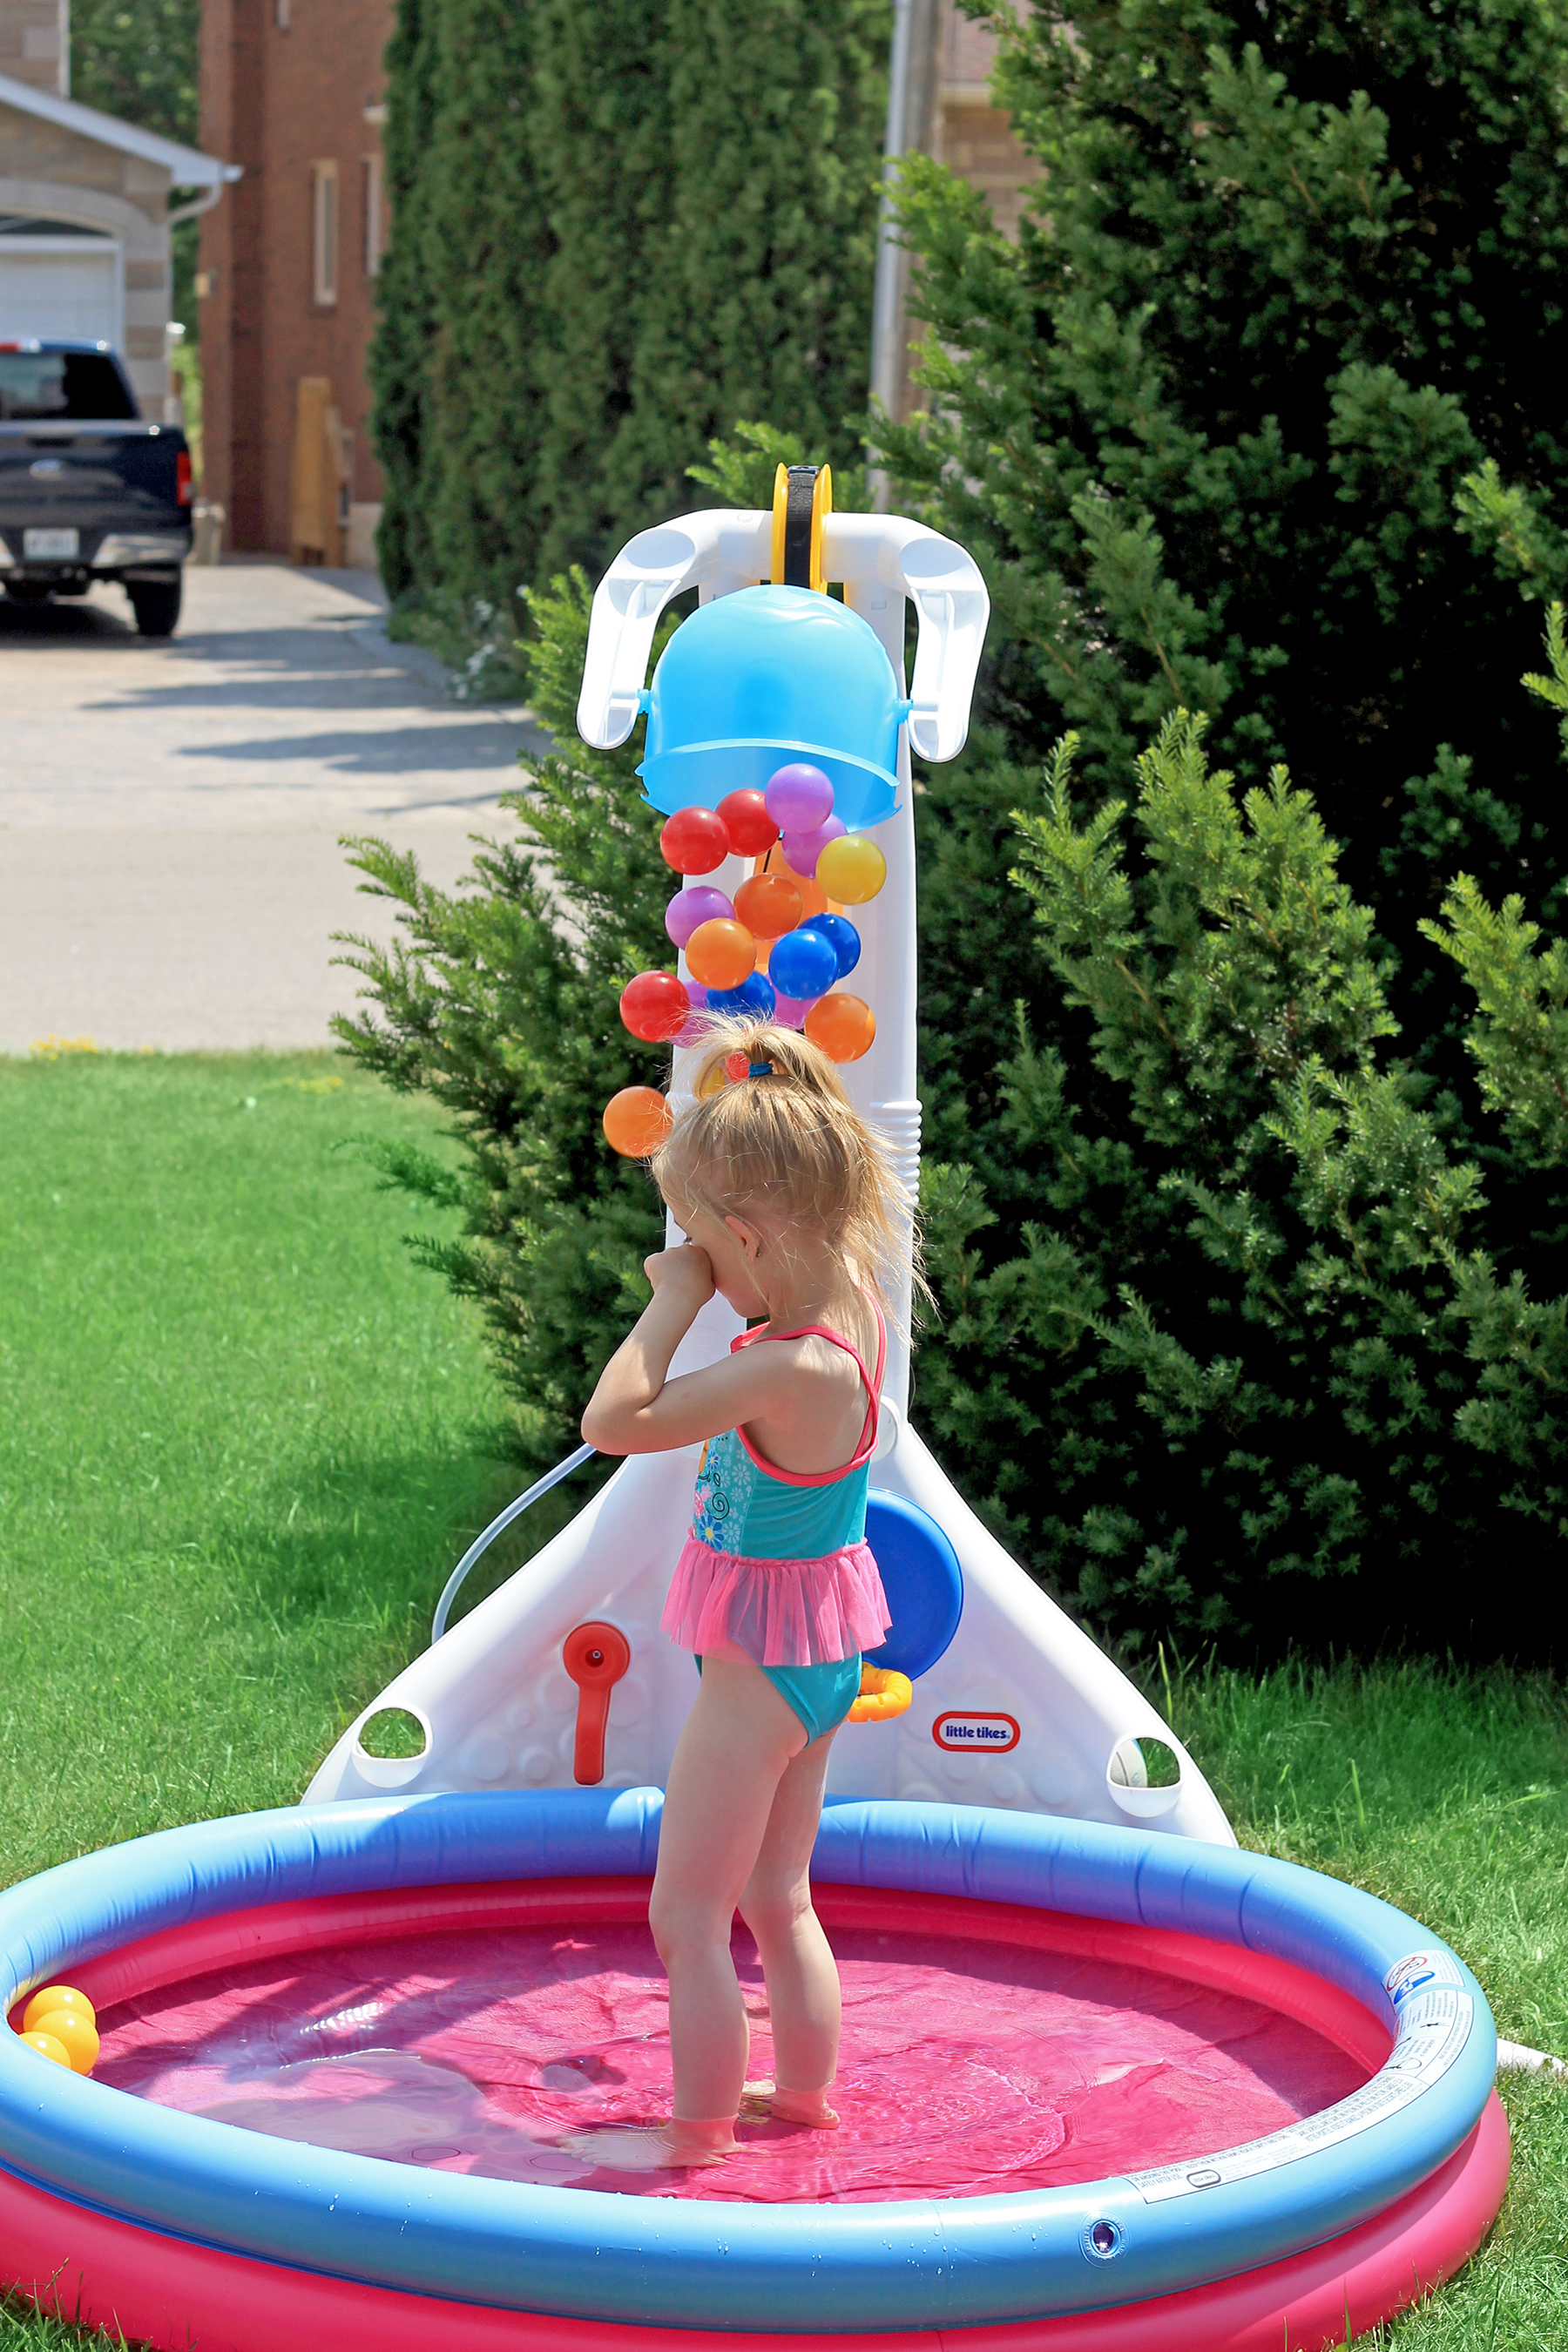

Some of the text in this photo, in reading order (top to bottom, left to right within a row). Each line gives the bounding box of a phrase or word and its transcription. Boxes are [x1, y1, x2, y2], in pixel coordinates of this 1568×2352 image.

[946, 1726, 1006, 1739] little tikes
[1136, 2179, 1158, 2187] SAFELY
[1154, 2175, 1173, 2184] AFTER
